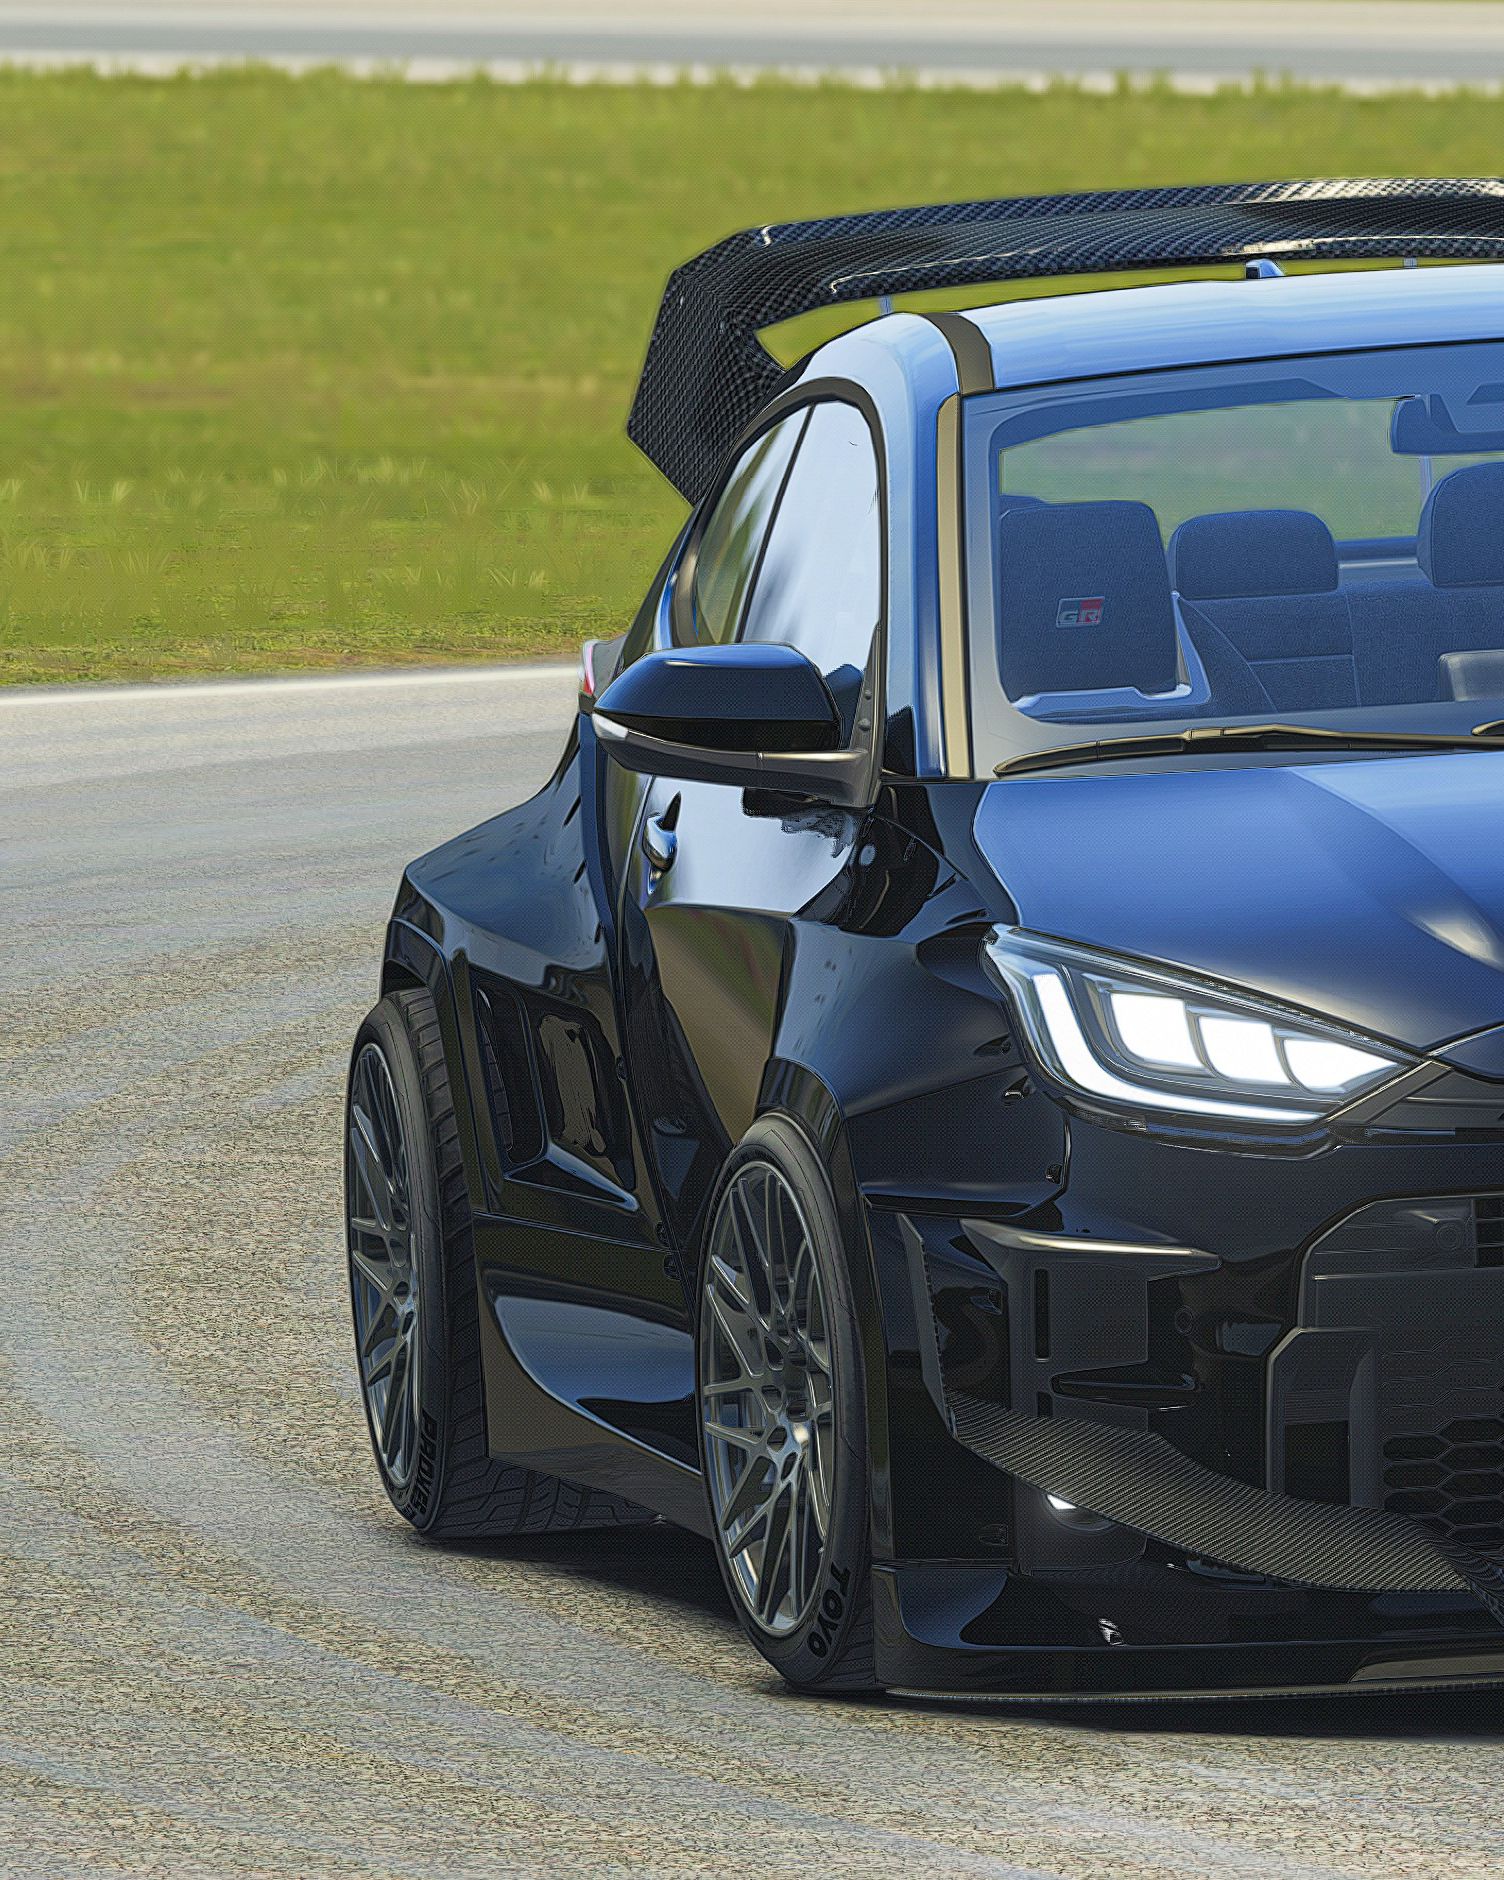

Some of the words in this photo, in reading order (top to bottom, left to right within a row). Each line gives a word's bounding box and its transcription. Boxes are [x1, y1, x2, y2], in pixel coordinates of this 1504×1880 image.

[1058, 608, 1101, 625] GR
[411, 1408, 438, 1515] PROXES
[807, 1560, 851, 1659] TOYO
